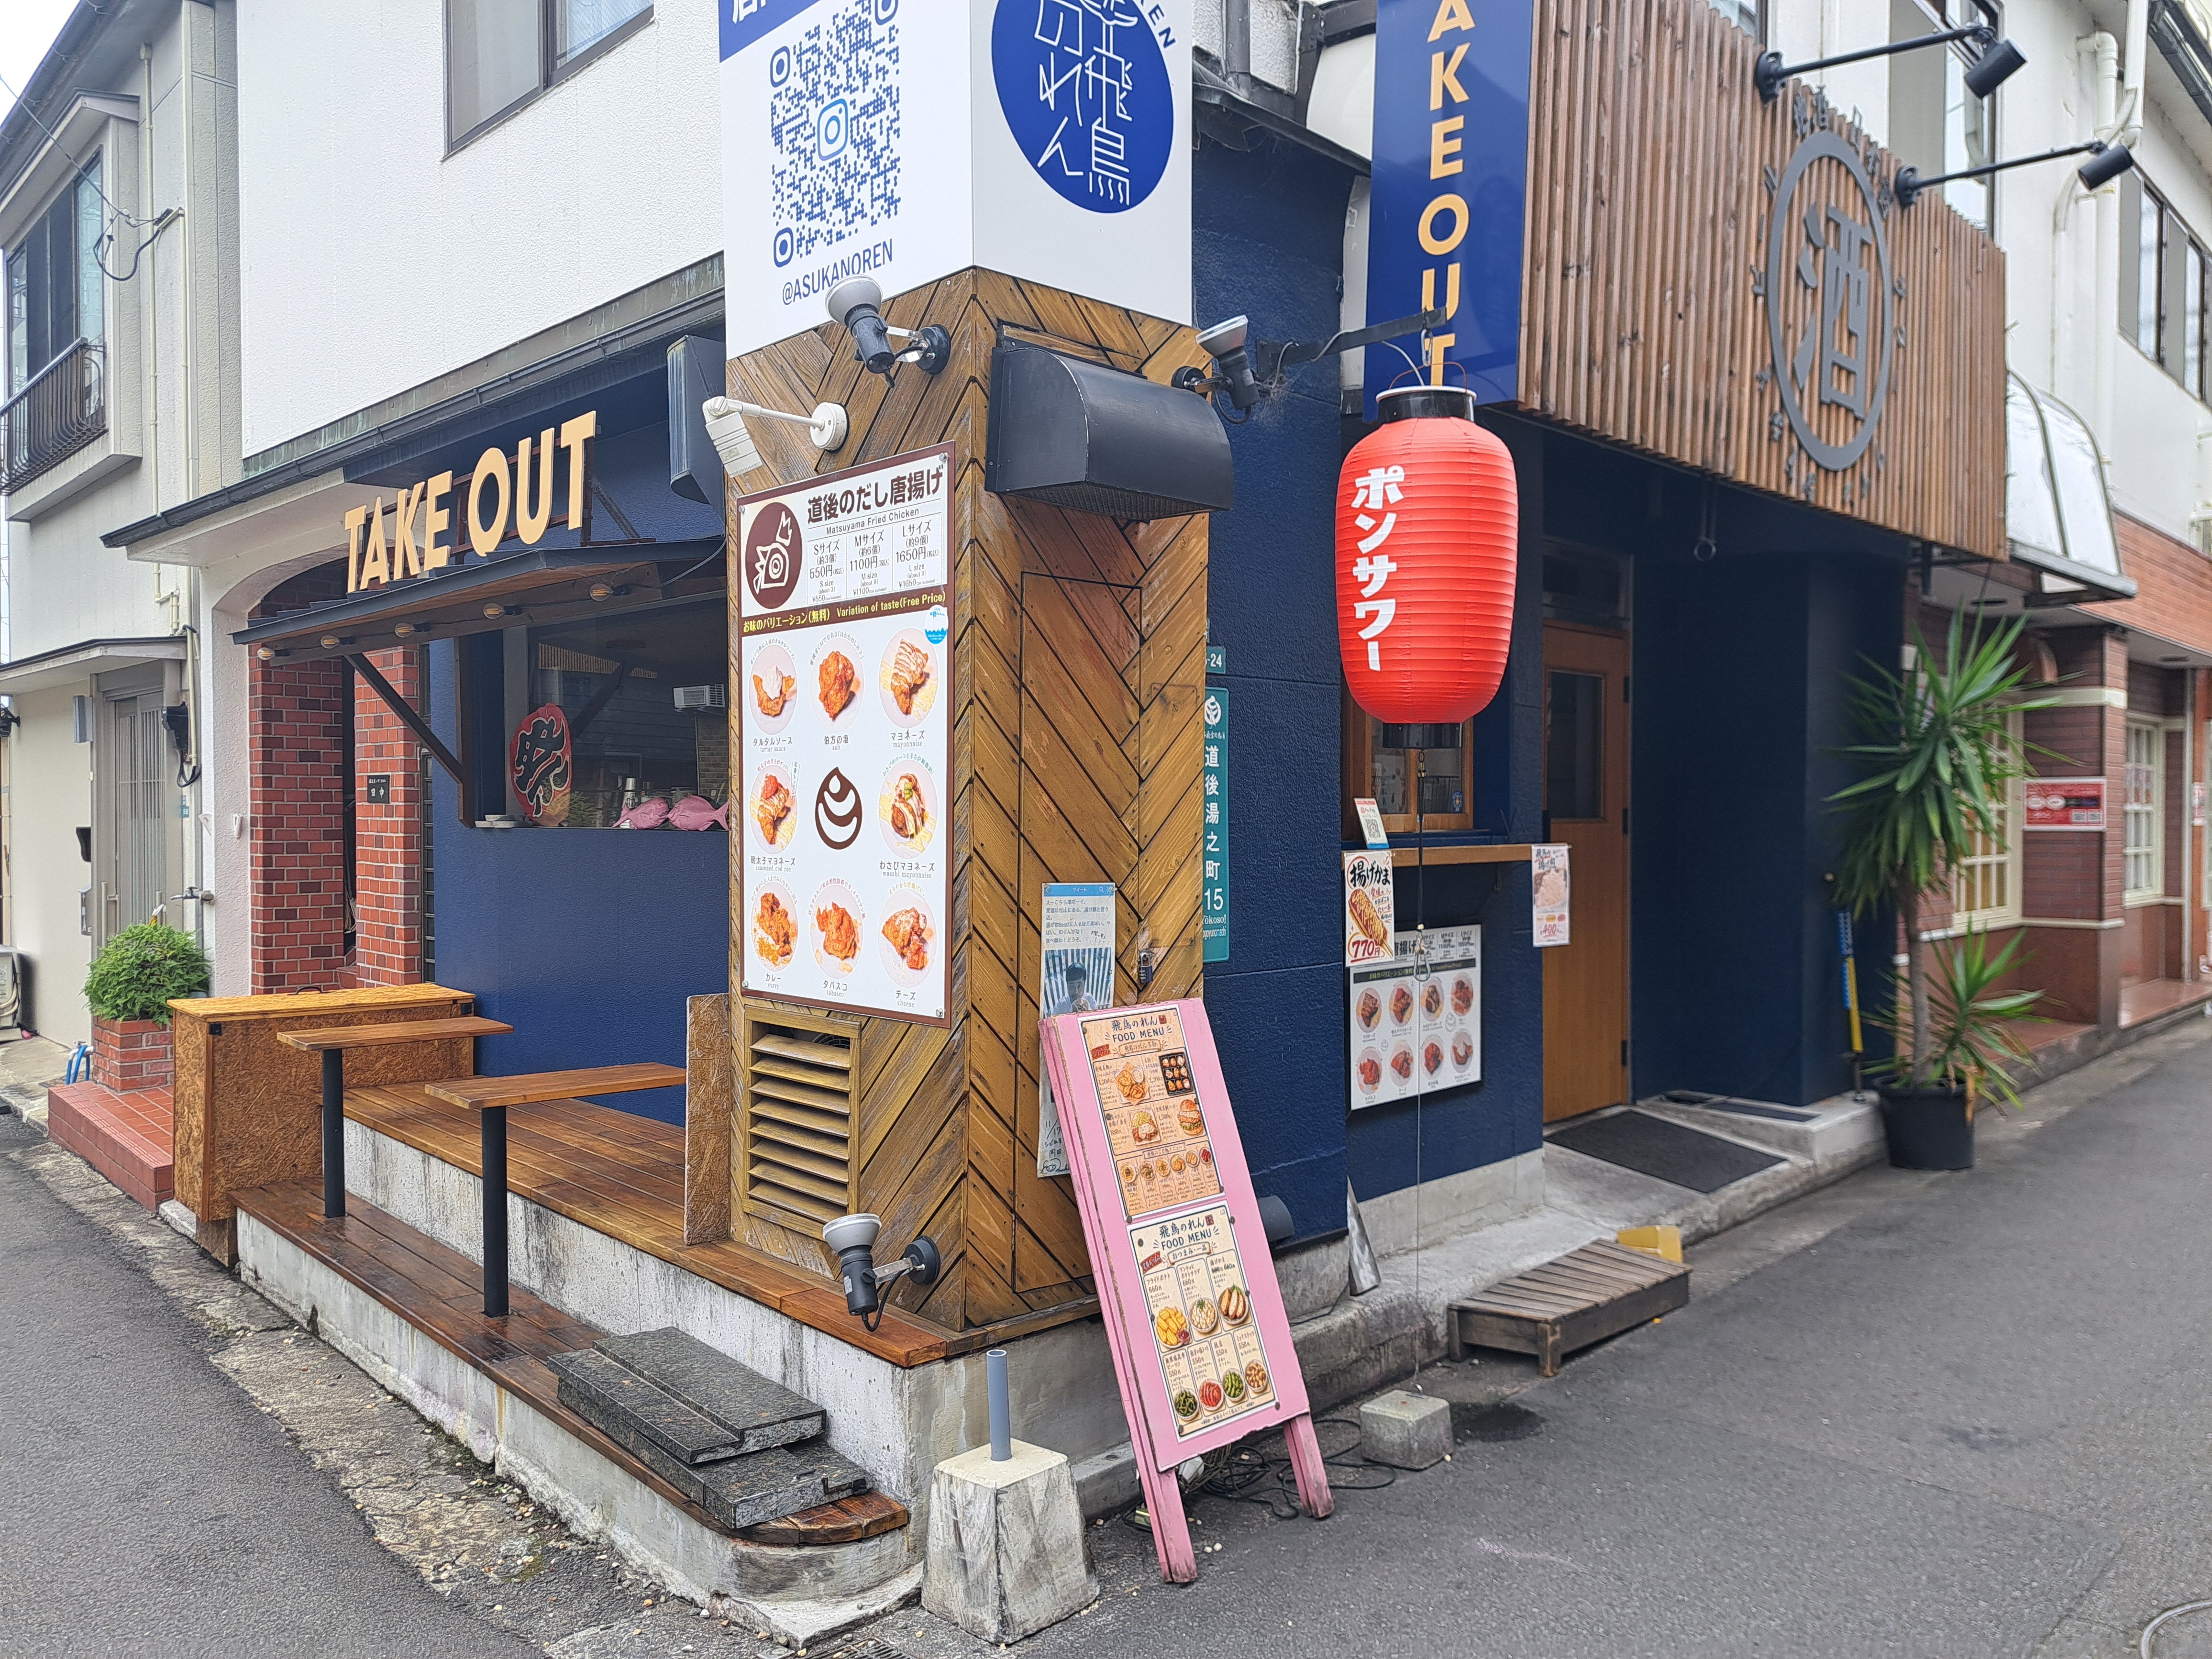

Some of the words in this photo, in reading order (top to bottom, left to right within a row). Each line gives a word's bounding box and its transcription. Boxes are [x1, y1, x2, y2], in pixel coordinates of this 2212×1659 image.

[1141, 0, 1176, 50] EN
[782, 238, 893, 305] @ASUKANOREN
[1794, 202, 1872, 420] 酒
[344, 470, 453, 593] TAKE
[467, 410, 597, 557] OUT
[808, 465, 944, 524] 道後のだし唐揚げ
[826, 521, 865, 535] Matsuyama
[867, 514, 886, 526] Fried
[889, 508, 919, 521] Chicken
[903, 520, 931, 537] Lサイズ
[814, 539, 840, 555] Sサイズ
[854, 530, 884, 547] Mサイズ
[1351, 465, 1405, 672] ポンサワー
[743, 608, 830, 633] お味のバリエーション(無料)
[837, 604, 868, 617] Variation
[871, 602, 878, 612] of
[921, 591, 946, 604] Price)
[1205, 653, 1222, 668] -24
[752, 737, 792, 746] タルタルソース
[824, 734, 849, 745] 伯方の塩
[890, 729, 925, 741] マヨネーズ
[893, 739, 923, 749] mayonnaise
[751, 856, 796, 867] 明太子マヨネーズ
[879, 861, 935, 872] わさびマヨネーズ
[1349, 860, 1391, 887] 揚げかま
[1204, 888, 1224, 910] 15
[1352, 939, 1380, 959] 770円
[765, 973, 782, 982] カレー
[823, 979, 848, 991] タバスコ
[895, 989, 916, 1001] チーズ
[1111, 1016, 1158, 1032] 飛鳥のれん
[1112, 1031, 1136, 1043] FOOD
[1139, 1027, 1164, 1038] MENU
[1159, 1217, 1205, 1239] 飛鳥のれん
[1161, 1236, 1184, 1251] FOOD
[1188, 1228, 1212, 1243] MENU
